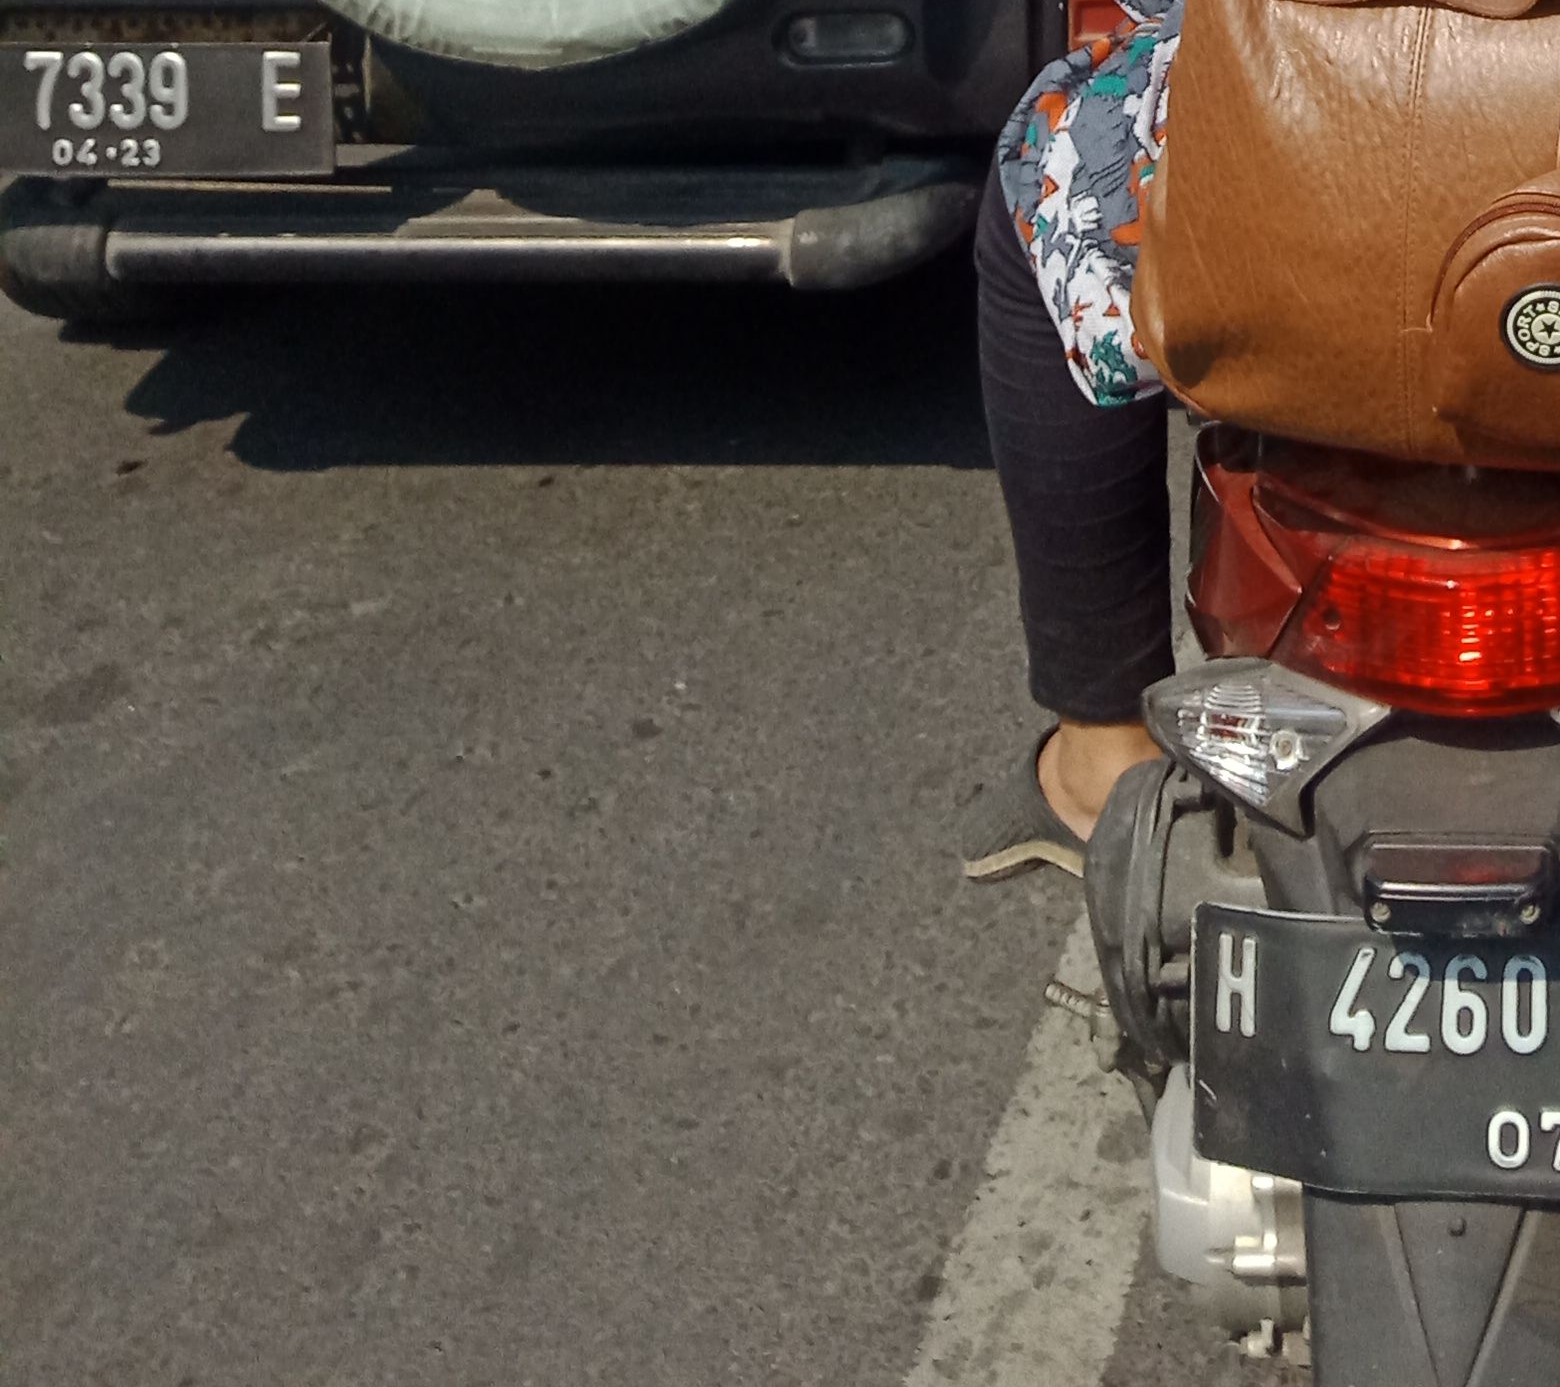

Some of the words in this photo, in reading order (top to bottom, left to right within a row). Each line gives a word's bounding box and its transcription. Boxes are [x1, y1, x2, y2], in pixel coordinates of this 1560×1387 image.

[23, 50, 190, 131] 7339
[262, 50, 301, 132] E
[1215, 932, 1257, 1038] H
[1328, 947, 1549, 1056] 4260
